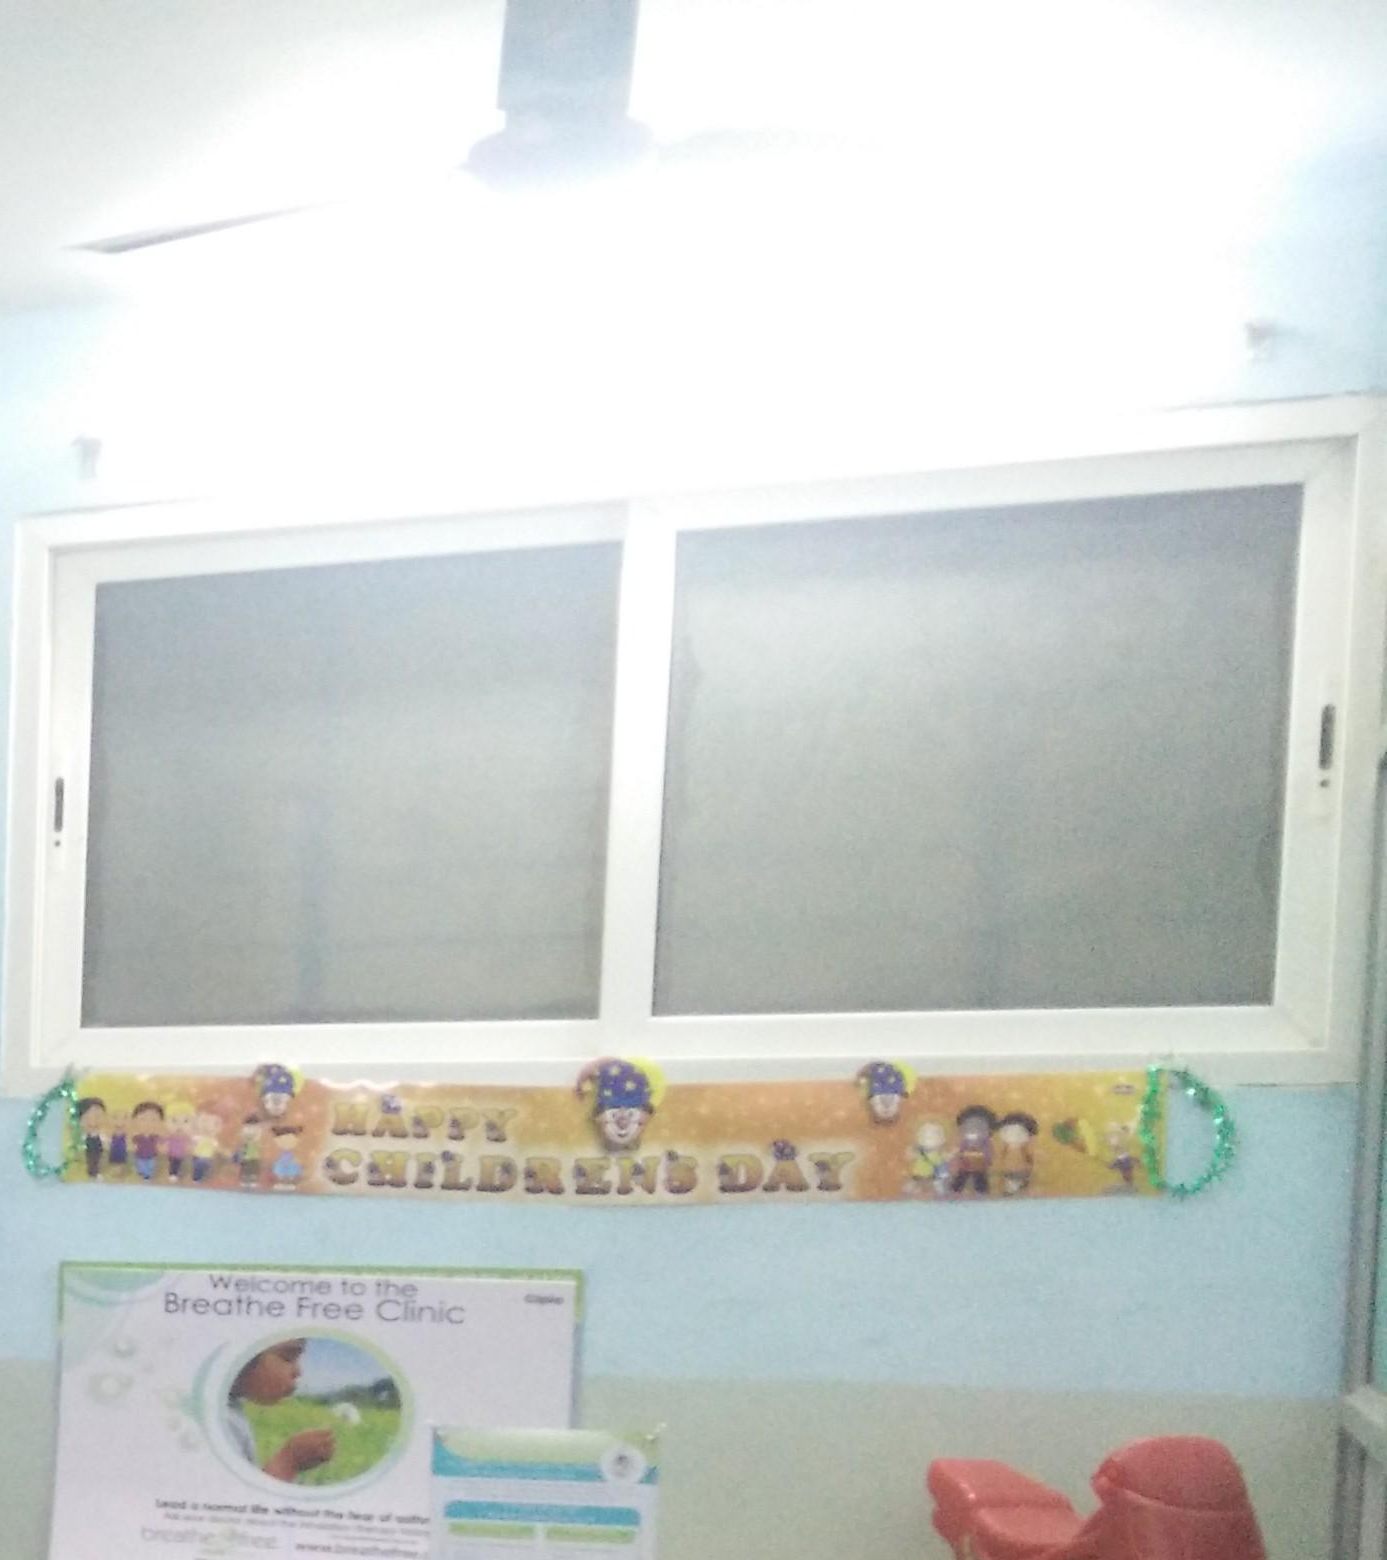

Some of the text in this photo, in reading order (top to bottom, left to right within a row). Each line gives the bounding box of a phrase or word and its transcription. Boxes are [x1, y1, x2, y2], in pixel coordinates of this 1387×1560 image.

[331, 1099, 518, 1142] HAPPY
[718, 1145, 856, 1193] DAY
[209, 1273, 419, 1299] Welcome to the
[163, 1291, 466, 1325] Breathe Free Clinic
